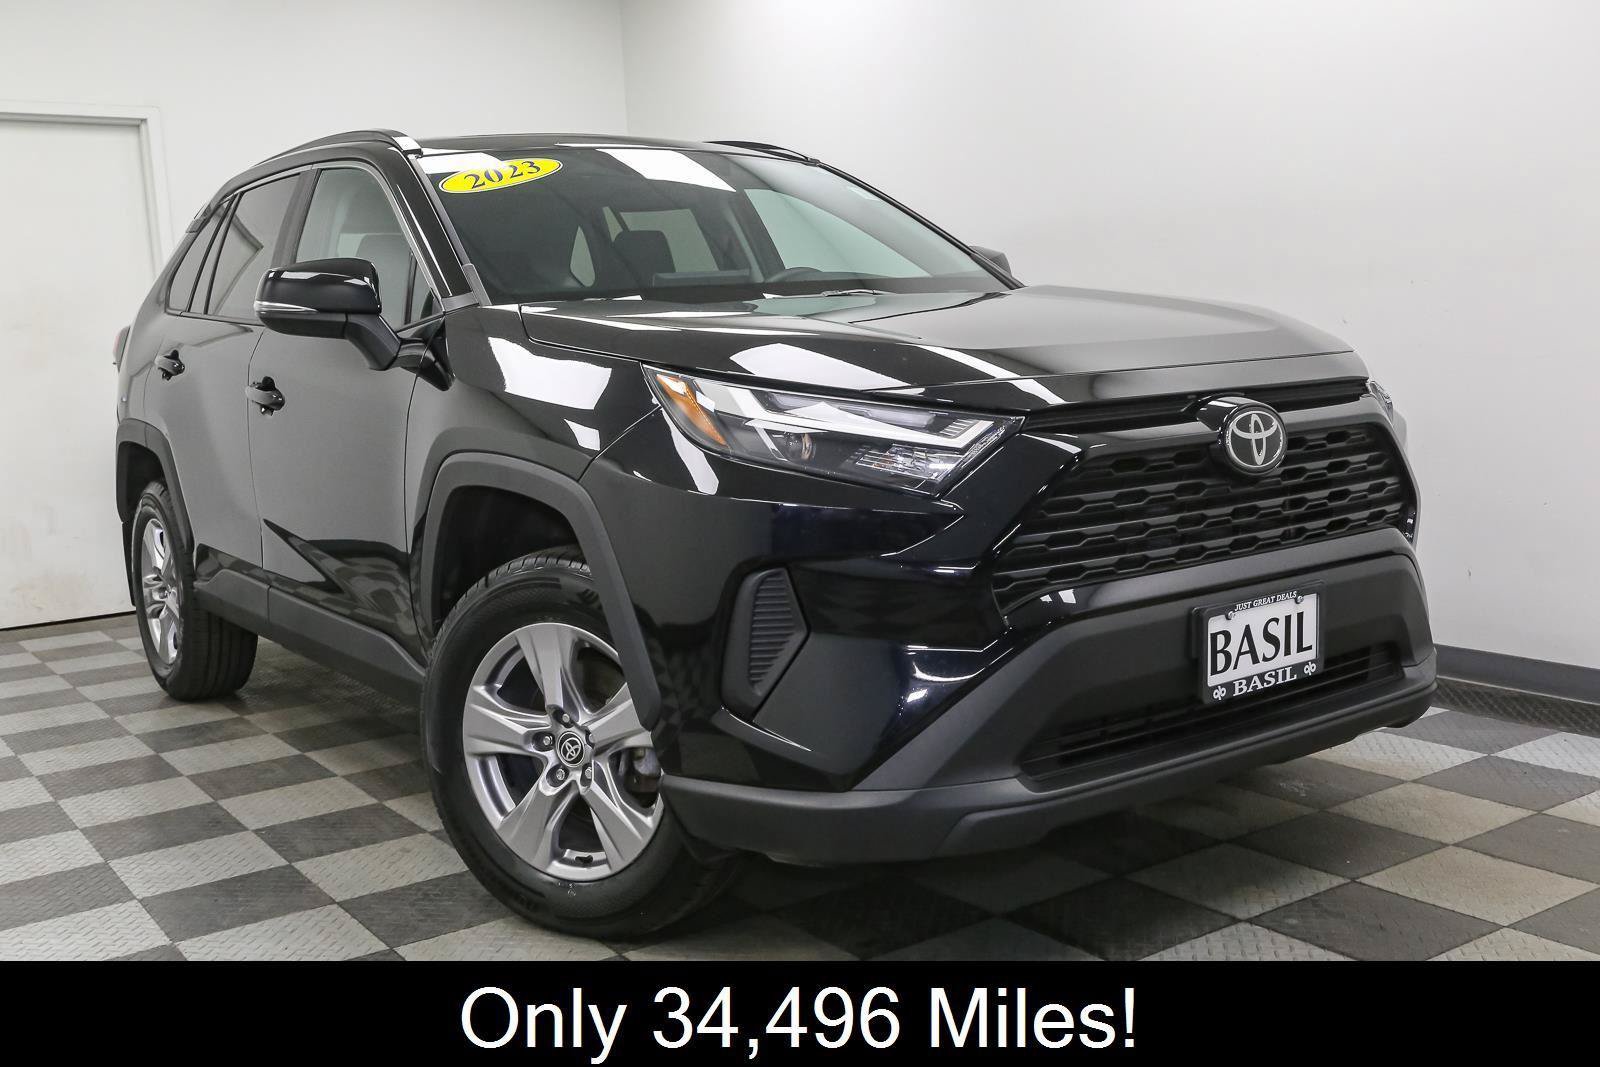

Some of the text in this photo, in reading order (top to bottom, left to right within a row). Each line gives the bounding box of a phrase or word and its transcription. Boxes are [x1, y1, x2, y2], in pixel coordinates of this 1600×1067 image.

[464, 160, 541, 190] 2023
[1234, 590, 1298, 612] JUST GREAT DEALS
[1210, 611, 1313, 677] BASIL
[1232, 666, 1297, 697] BASIL
